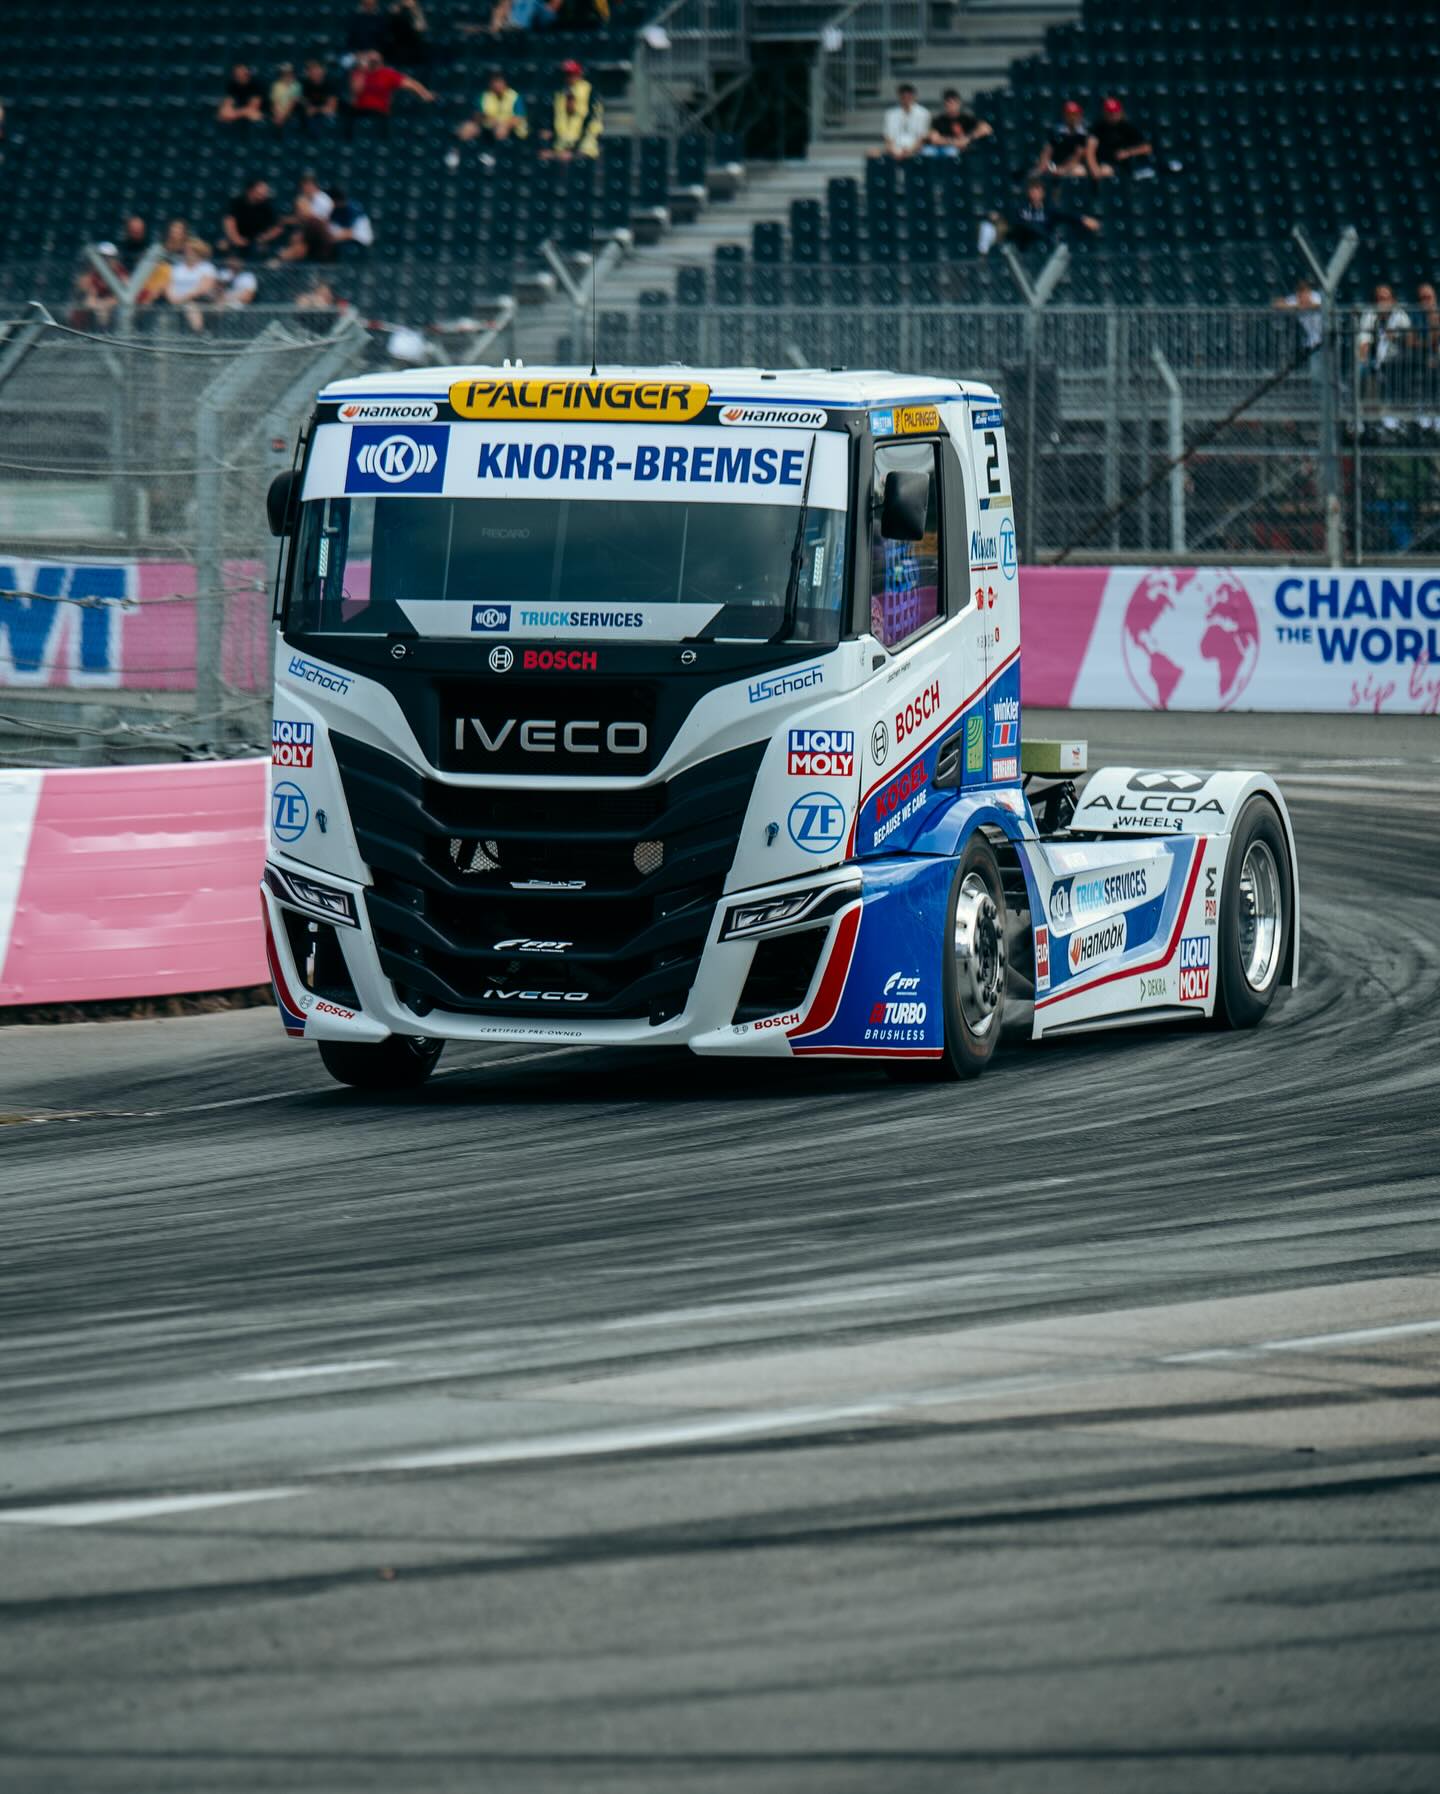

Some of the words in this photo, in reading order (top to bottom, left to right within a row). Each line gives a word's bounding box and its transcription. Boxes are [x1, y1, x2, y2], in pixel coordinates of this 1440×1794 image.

[466, 382, 692, 410] PALFINGER
[477, 443, 805, 486] KNORR-BREMSE
[984, 431, 1001, 493] 2
[1275, 579, 1440, 620] CHANG
[1276, 627, 1313, 643] THE
[523, 650, 598, 670] BOSCH
[1350, 673, 1396, 713] sip
[896, 680, 940, 744] BOSCH
[455, 718, 647, 754] IVECO
[792, 731, 851, 752] LIQUI
[791, 753, 853, 775] MOLY
[274, 793, 305, 831] ZF
[1083, 795, 1225, 815] ALCOA
[791, 804, 844, 840] ZF
[874, 809, 901, 847] BECAUSE
[912, 789, 927, 814] CARE
[1117, 815, 1183, 828] WHEELS
[1181, 938, 1210, 968] LIQUI
[897, 977, 920, 990] FPT
[1147, 978, 1166, 996] DEKRA
[1180, 969, 1209, 999] MOLY
[483, 989, 589, 1001] IVECO
[315, 1001, 355, 1019] BOSCH
[528, 1028, 583, 1037] PRE-OWNED
[754, 1013, 800, 1030] BOSCH
[864, 1029, 924, 1041] BRUSHLESS
